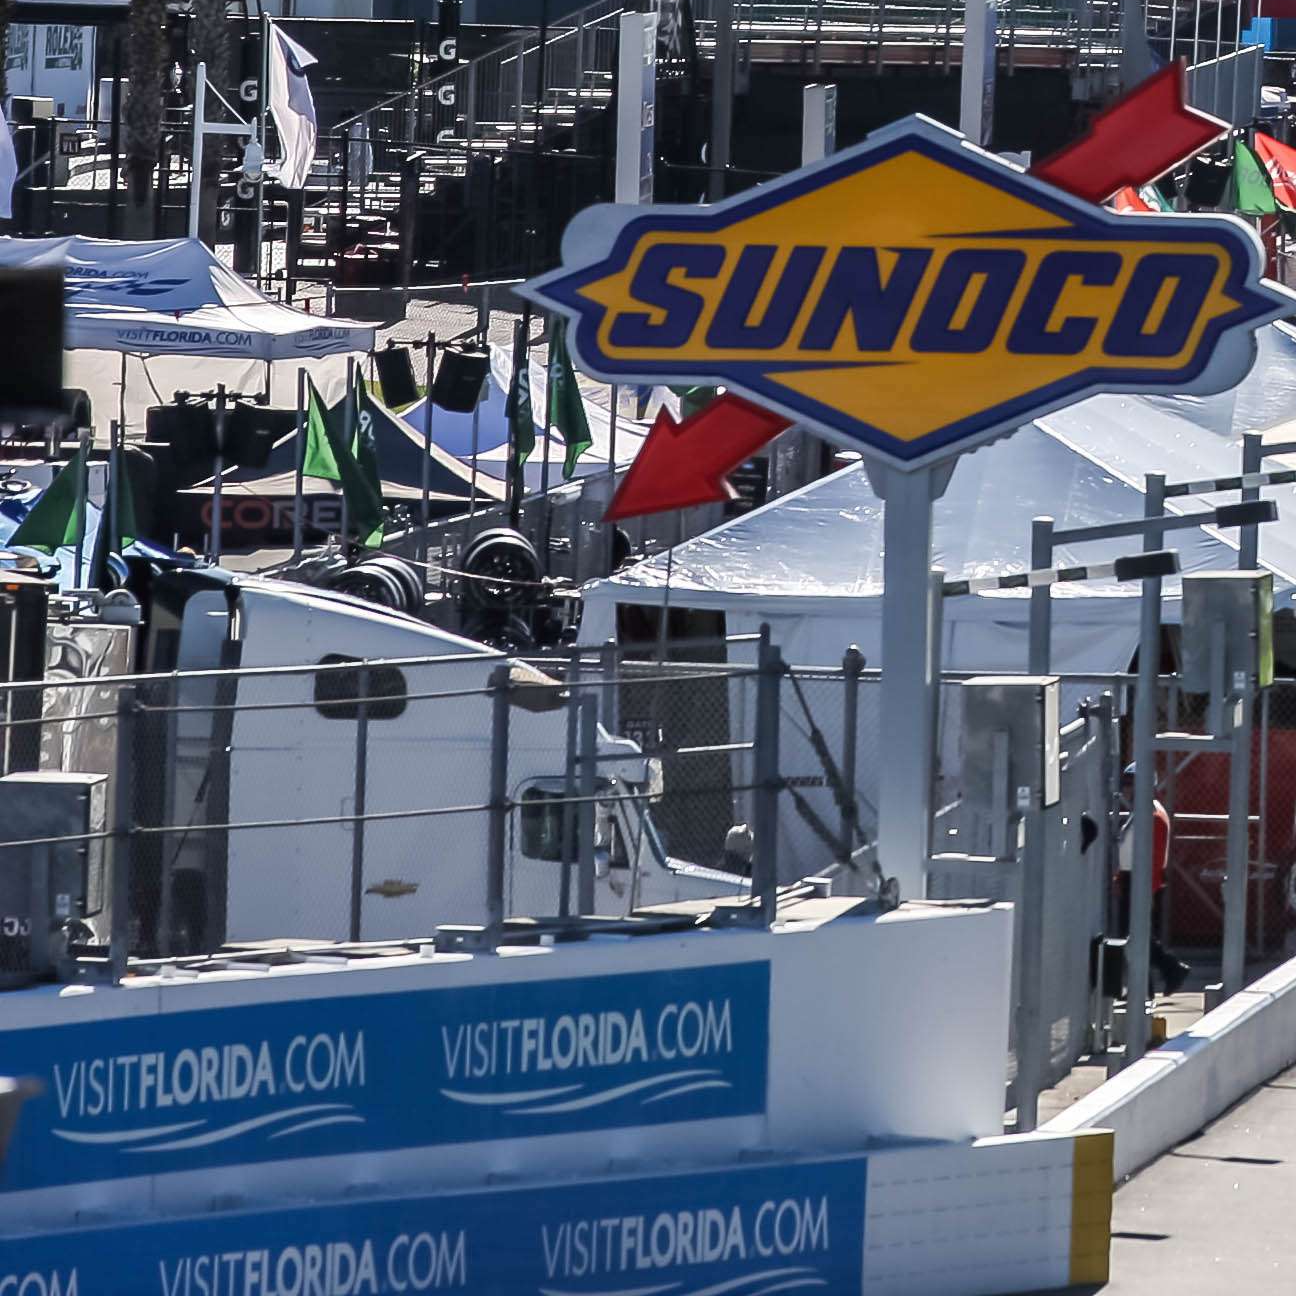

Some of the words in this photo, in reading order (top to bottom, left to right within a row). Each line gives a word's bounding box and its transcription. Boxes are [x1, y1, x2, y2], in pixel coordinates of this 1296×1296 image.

[116, 327, 252, 347] VISITFLORIDA.COM
[607, 242, 1221, 358] SUNOCO
[202, 497, 342, 529] CORE
[54, 1031, 366, 1119] VISITFLORIDA.COM
[441, 999, 733, 1080] VISITFLORIDA.COM
[160, 1229, 466, 1296] VISITFLORIDA.COM
[541, 1197, 830, 1278] VISITFLORIDA.COM
